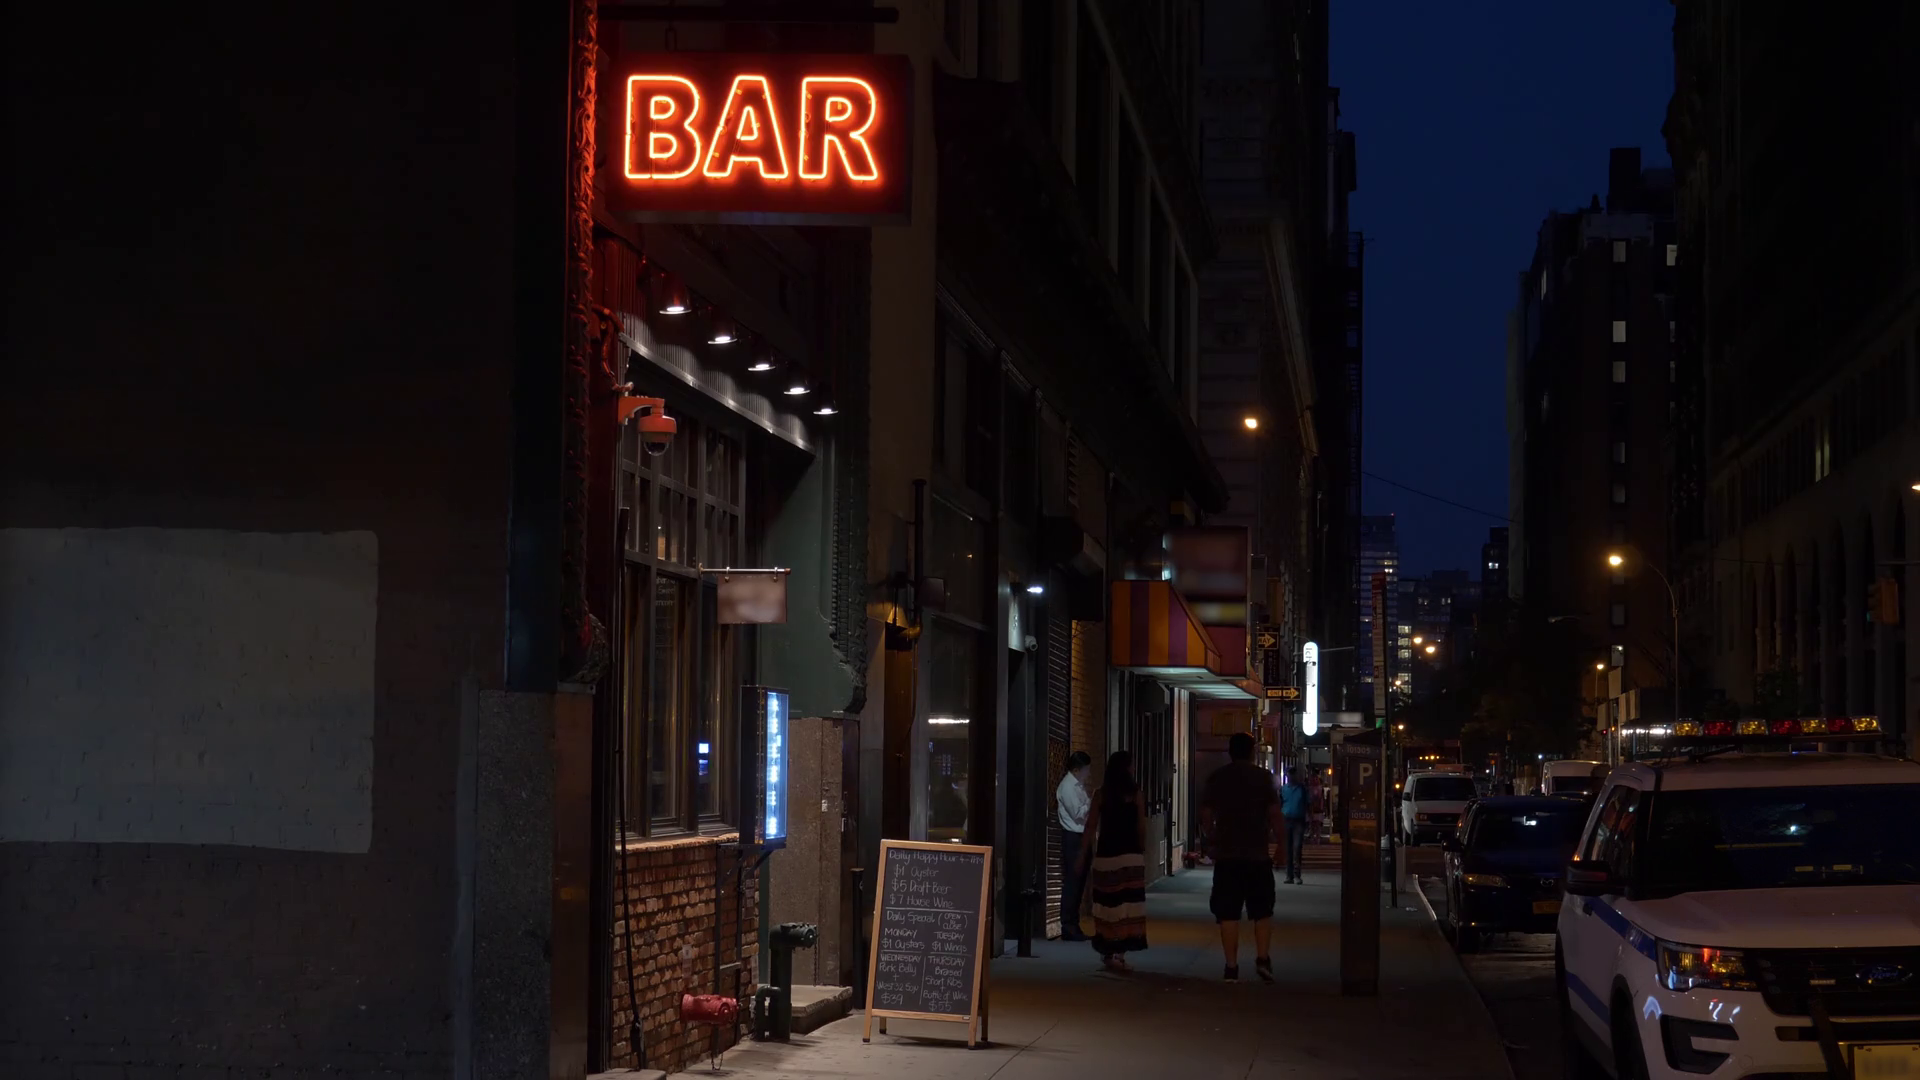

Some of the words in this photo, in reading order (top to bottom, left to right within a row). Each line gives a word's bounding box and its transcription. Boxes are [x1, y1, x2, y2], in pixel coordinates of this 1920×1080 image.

[623, 74, 880, 181] BAR
[1359, 762, 1373, 786] P
[1351, 812, 1376, 820] 101305
[889, 850, 911, 865] Daily
[913, 850, 938, 864] Happy
[940, 853, 958, 863] Hour
[894, 864, 905, 878] $1
[911, 867, 939, 881] Oyster
[891, 878, 907, 893] $5
[909, 881, 931, 896] Draft
[932, 882, 952, 894] Beer
[906, 895, 930, 907] House
[933, 897, 955, 909] Wine
[886, 910, 905, 924] Daily
[884, 927, 918, 938] MONDAY
[933, 931, 965, 941] TUESDAY
[881, 937, 892, 949] $1
[894, 939, 925, 951] Oysters
[931, 941, 942, 951] $1
[944, 942, 967, 954] Wings
[880, 953, 922, 963] WEDNESDAY
[927, 955, 966, 967] THURSDAY
[879, 963, 896, 972] Pork
[898, 963, 917, 977] Belly
[925, 976, 945, 986] Short
[947, 976, 963, 988] Ribs
[880, 992, 904, 1005] $39
[923, 990, 942, 1000] Bottle
[928, 1000, 953, 1011] $55
